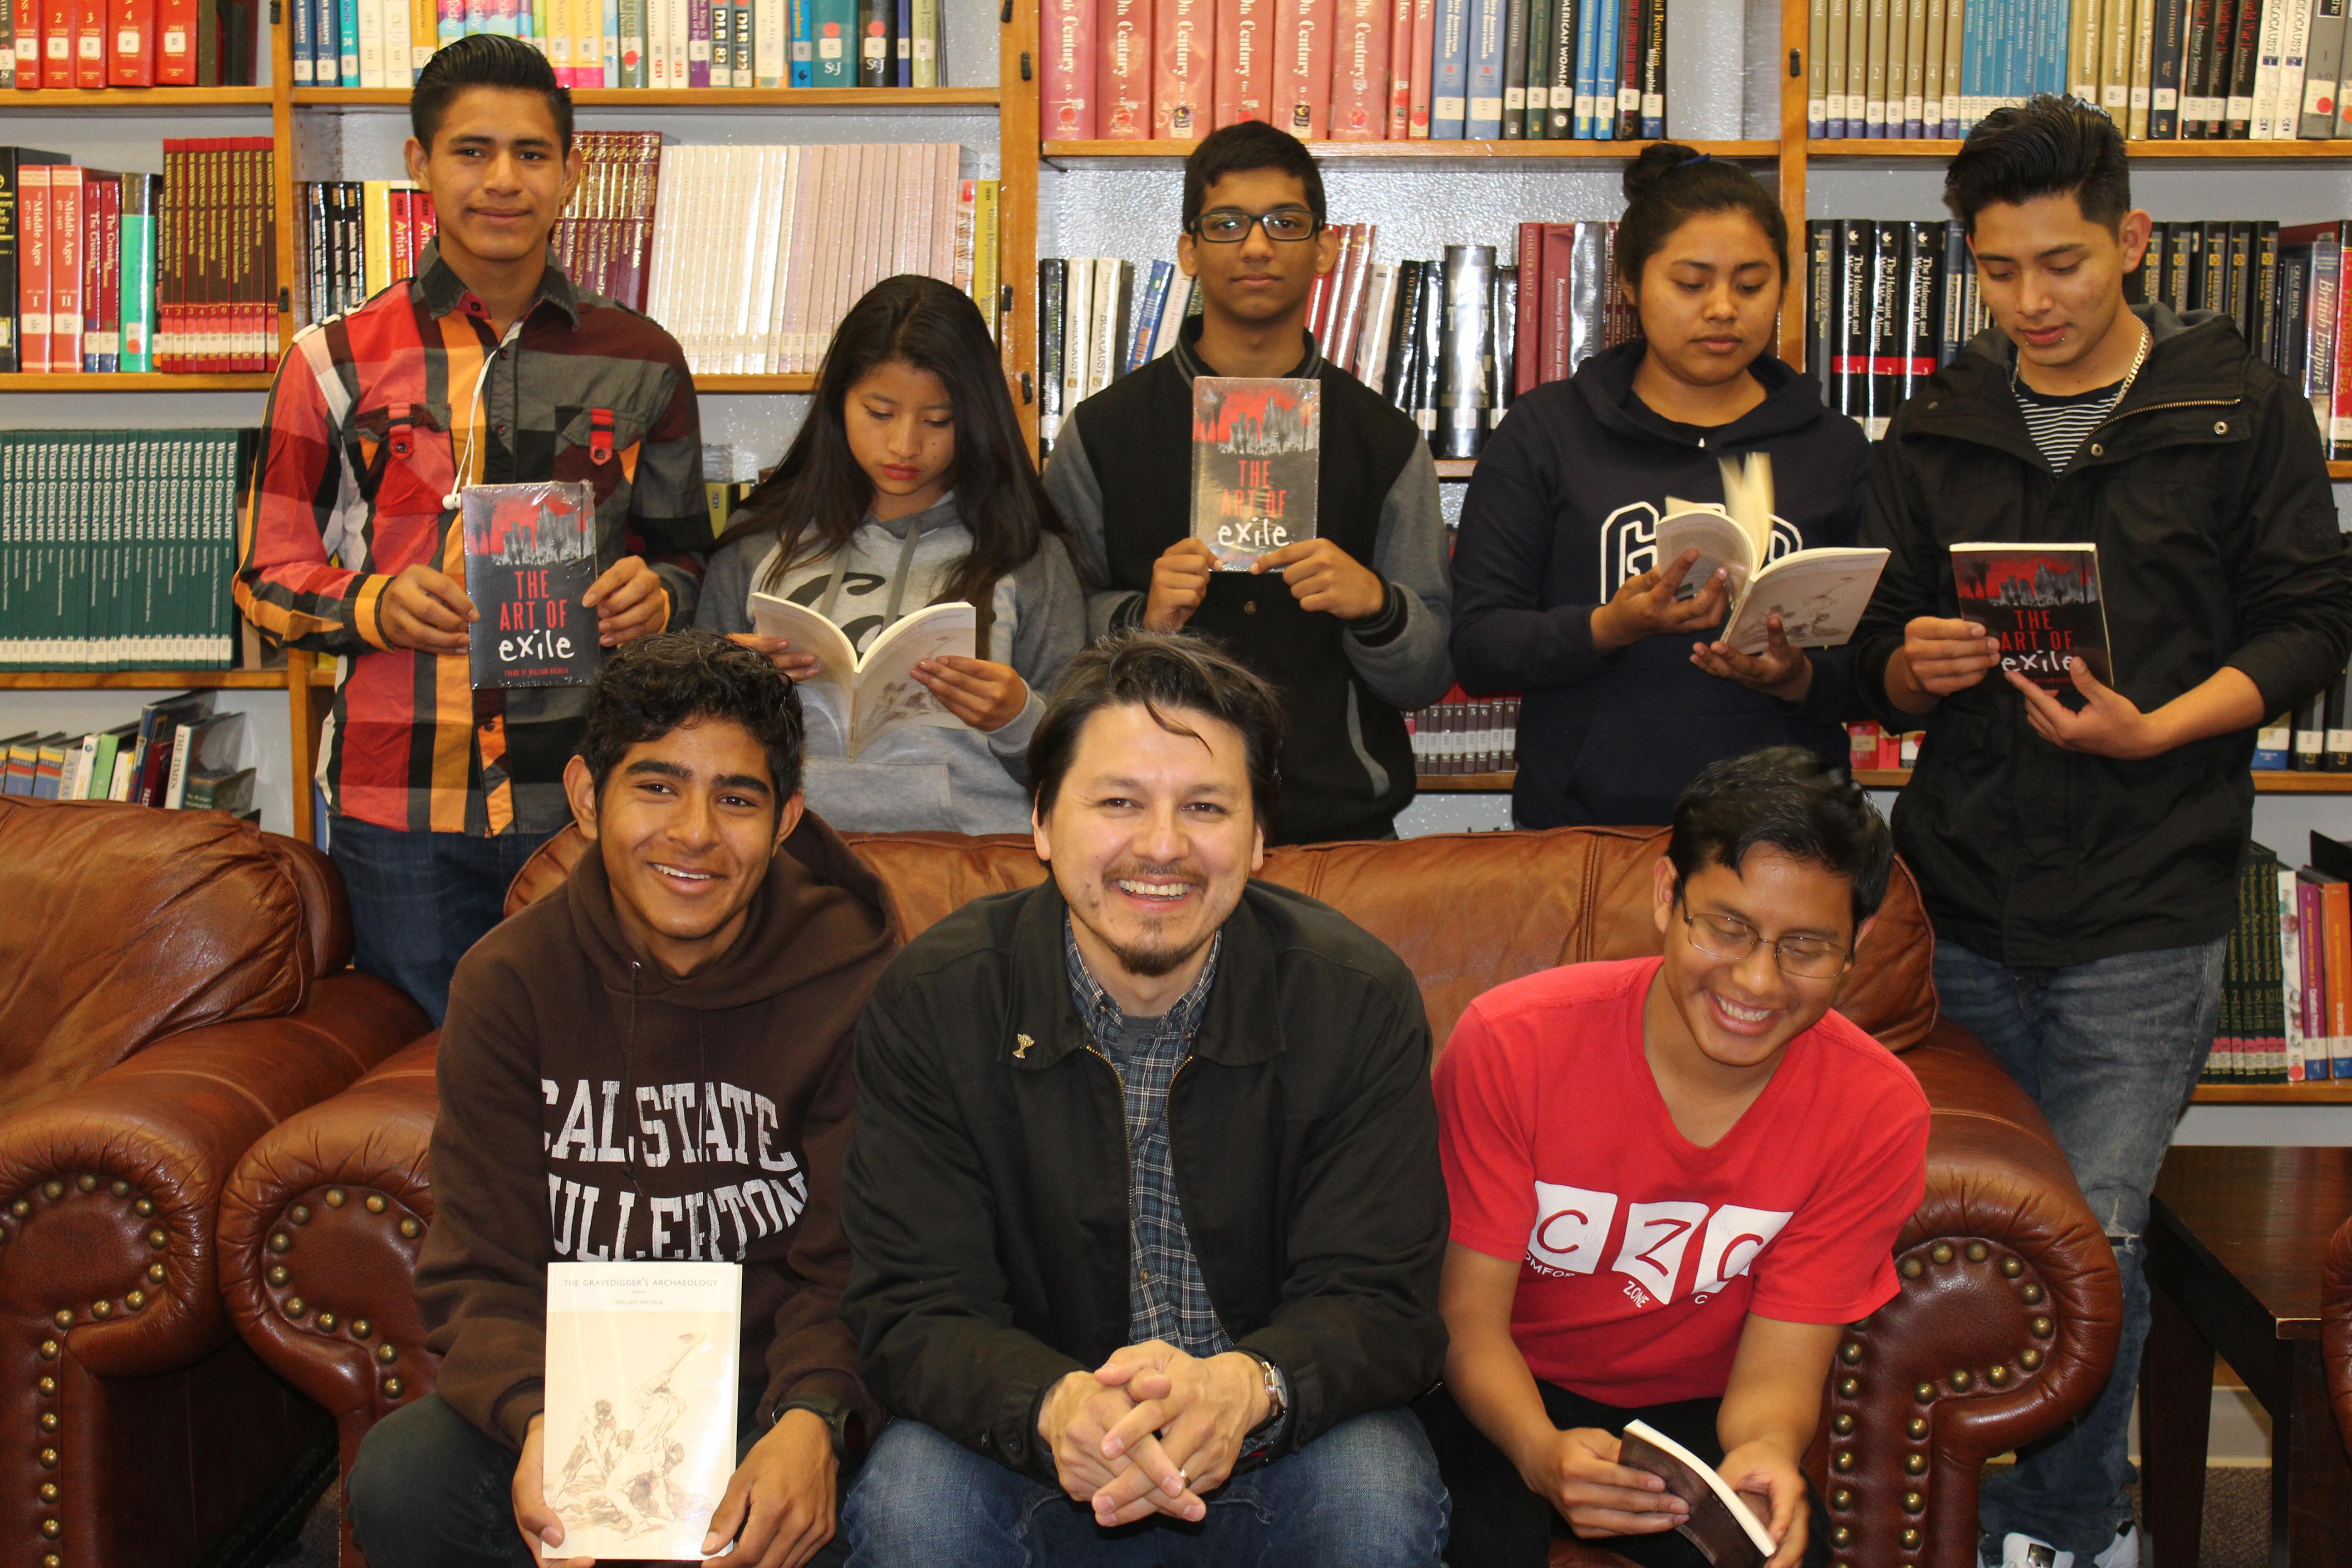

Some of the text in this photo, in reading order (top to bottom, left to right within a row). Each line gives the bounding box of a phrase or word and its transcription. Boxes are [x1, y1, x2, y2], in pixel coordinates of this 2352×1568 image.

[22, 13, 28, 24] 1
[54, 12, 63, 23] 2
[86, 12, 94, 23] 3
[125, 10, 133, 21] 4
[714, 10, 726, 64] DLB 82
[1512, 0, 1520, 47] UNFIGHTERS
[2266, 0, 2281, 54] OLOCAUST
[2290, 0, 2307, 54] OLOCAUST
[736, 10, 748, 70] DLB 122
[1058, 16, 1078, 74] Century
[1113, 20, 1133, 77] Century
[1176, 20, 1194, 77] Century
[1236, 20, 1256, 77] Century
[1294, 20, 1314, 78] Century
[1351, 22, 1371, 77] Century
[1558, 0, 1570, 88] MERICAN WOMEN
[1653, 14, 1664, 66] Revolution
[2085, 32, 2095, 74] Reformation
[2116, 34, 2126, 77] Reformation
[2191, 24, 2204, 86] Primary Sources
[2238, 49, 2248, 83] Almanac
[31, 201, 43, 266] Middle Ages
[62, 200, 75, 265] Middle Ages
[89, 212, 98, 269] The Crusades
[106, 213, 116, 270] The Crusades
[395, 220, 407, 258] Artists
[957, 222, 966, 247] World
[985, 233, 995, 275] Depression
[1913, 256, 1923, 284] World
[2213, 270, 2221, 312] HISTOR
[1172, 278, 1188, 310] American
[1555, 278, 1565, 315] Reminiscing
[1852, 255, 1863, 335] The Holocaust and
[1884, 256, 1896, 336] The Holocaust and
[1913, 284, 1921, 305] War
[1920, 257, 1932, 337] The Holocaust and
[1401, 308, 1412, 351] BIOLOGISTS
[1556, 317, 1564, 331] with
[1875, 314, 1883, 352] Almanac
[2311, 279, 2335, 385] British Empire
[2338, 289, 2352, 395] VICTORIAN ERA
[3, 444, 13, 542] WORLD GEOGRAPHY
[47, 444, 59, 542] WORLD GEOGRAPHY
[92, 444, 104, 542] WORLD GEOGRAPHY
[179, 441, 191, 540] WORLD GEOGRAPHY
[225, 441, 236, 540] WORLD GEOGRAPHY
[1238, 460, 1272, 487] THE
[1220, 489, 1288, 517] ART OF
[1217, 516, 1290, 547] exile
[514, 570, 550, 599] THE
[500, 599, 568, 631] ART OF
[2014, 610, 2053, 630] THE
[499, 628, 575, 662] exile
[2001, 630, 2073, 652] ART OF
[2001, 650, 2073, 672] exile
[61, 761, 75, 797] ATLAS
[169, 757, 181, 789] TIMES
[635, 1082, 798, 1172] STATE
[548, 1171, 808, 1262] ULLERTON
[583, 1276, 649, 1287] GRAVEDIGGER'S
[1525, 1251, 1575, 1278] OMFOR
[1622, 1280, 1650, 1308] ZONE
